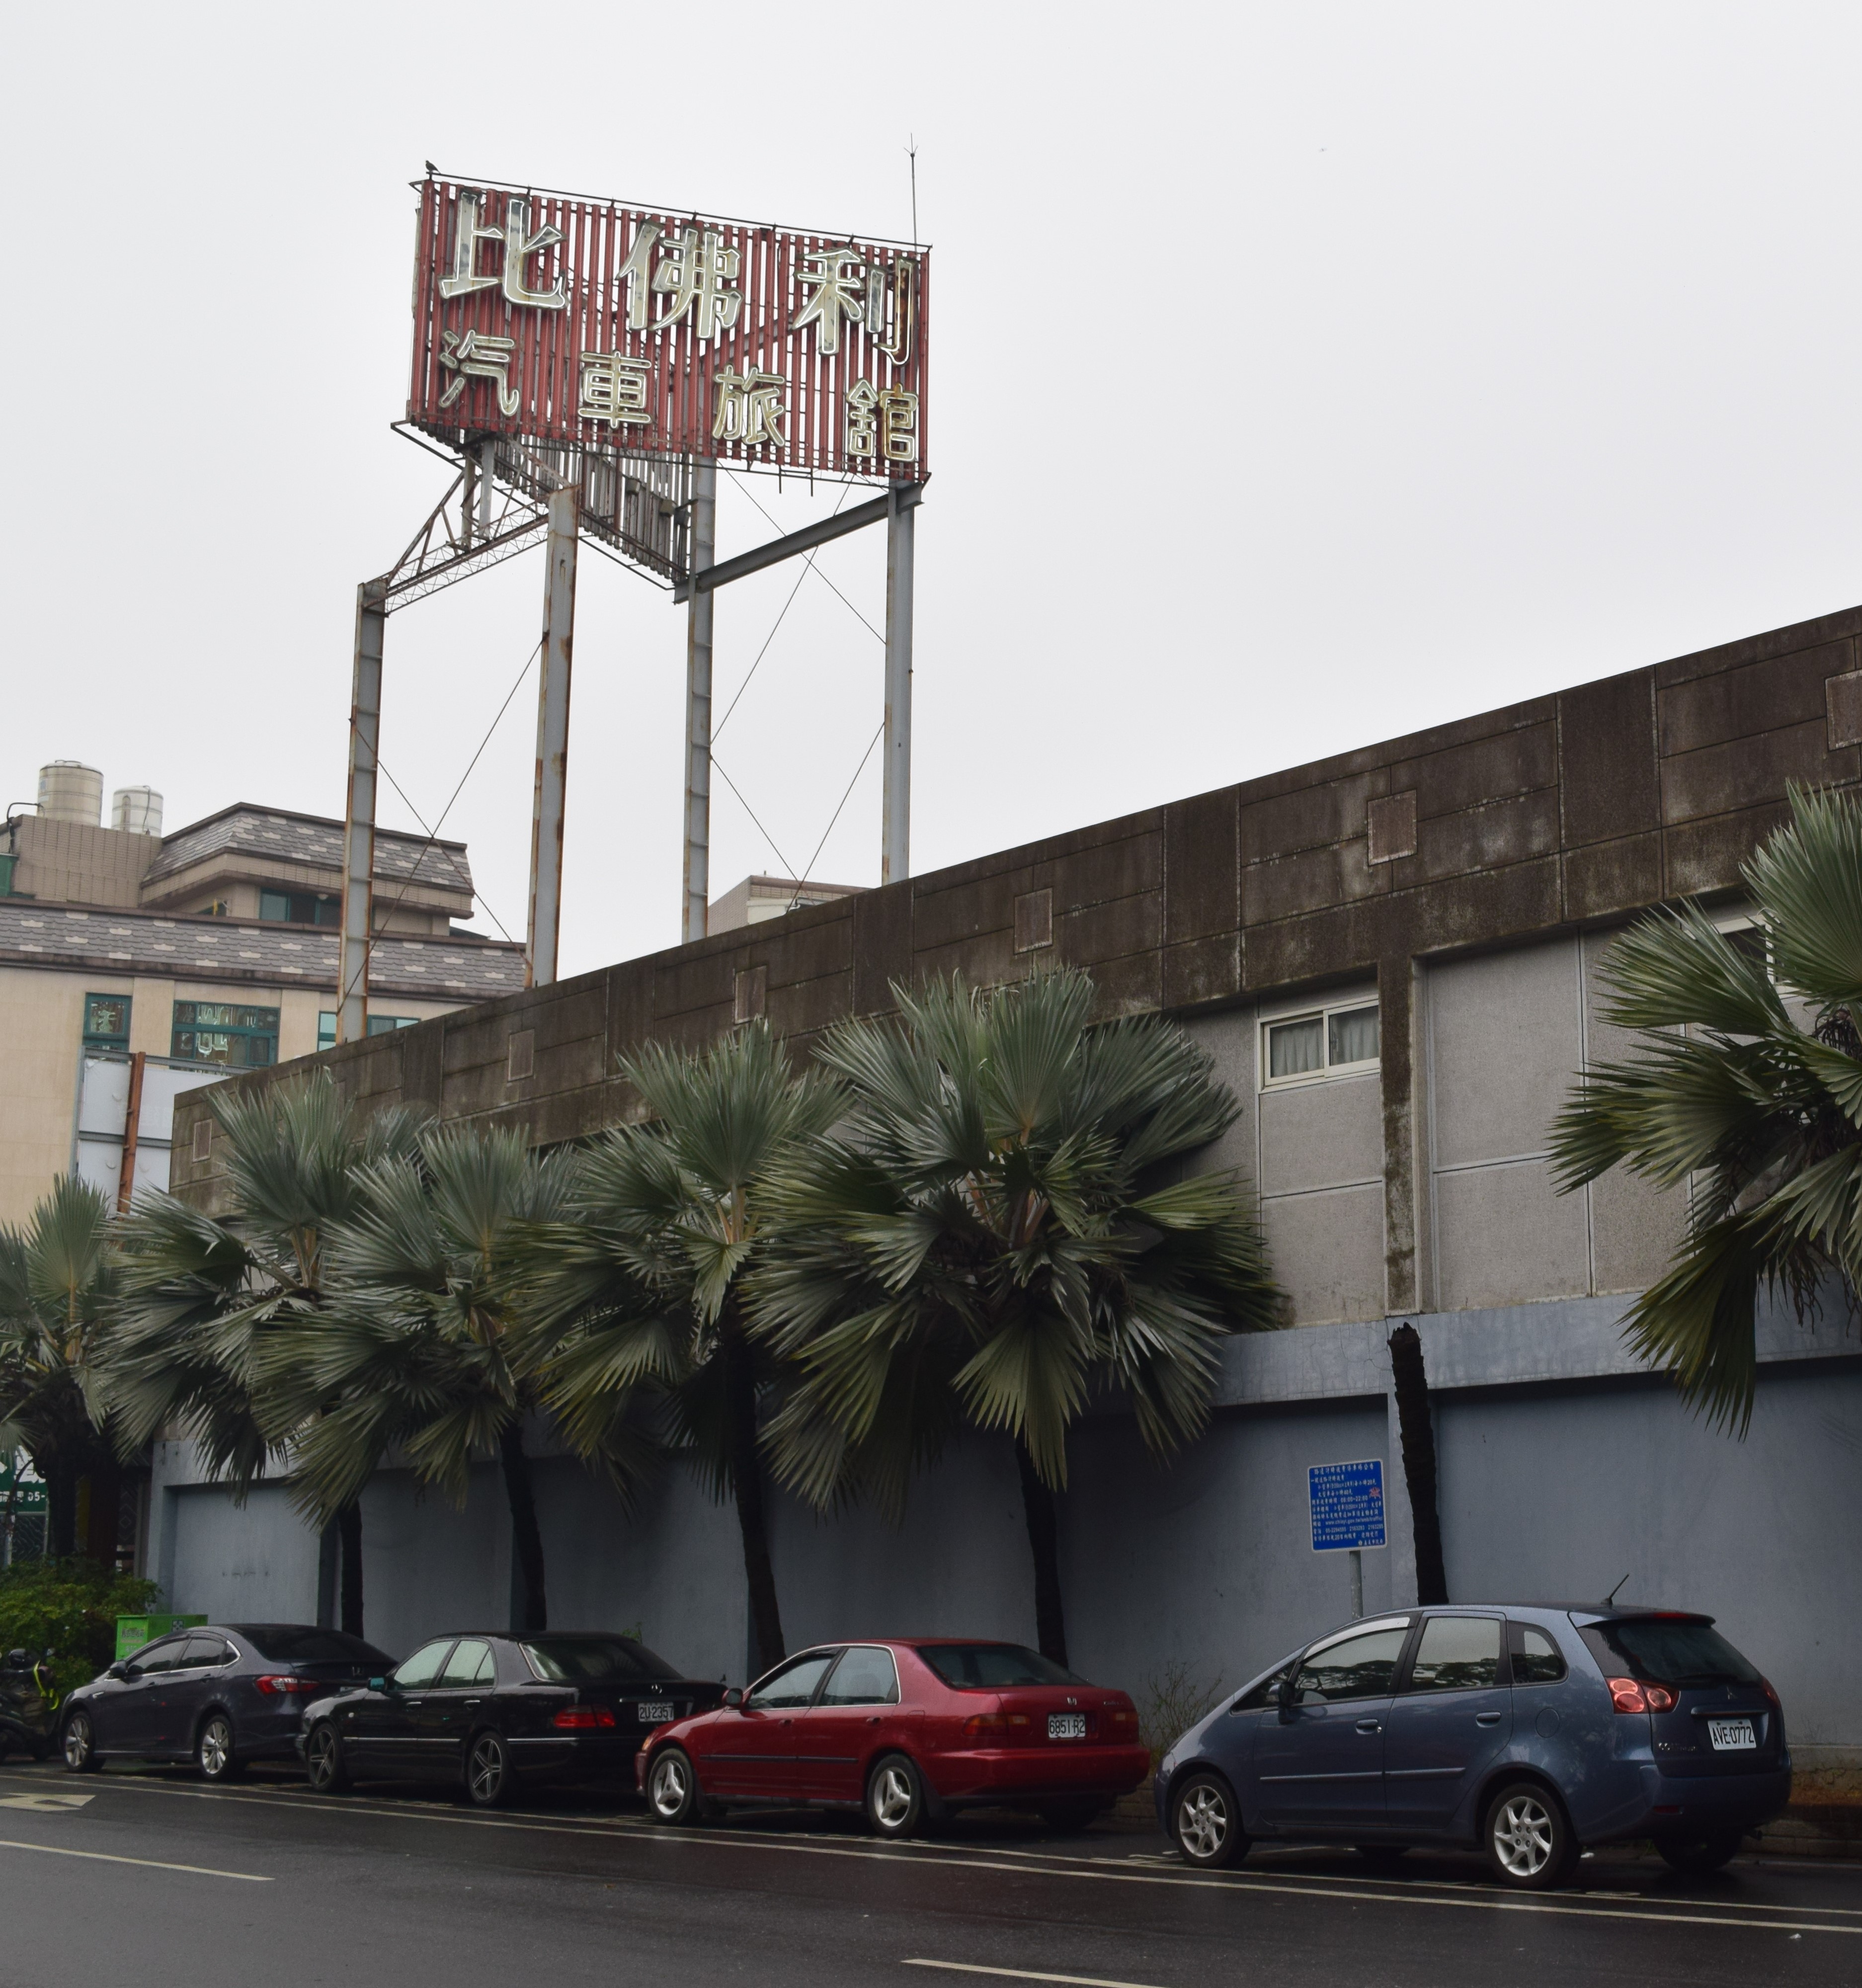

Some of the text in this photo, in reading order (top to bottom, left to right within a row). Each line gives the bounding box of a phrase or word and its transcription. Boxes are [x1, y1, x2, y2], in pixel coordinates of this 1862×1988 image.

[437, 187, 916, 367] 比佛利
[439, 329, 919, 462] 汽車旅館
[639, 1706, 674, 1719] 2U-2357
[1049, 1719, 1085, 1735] 6851-R2
[1712, 1726, 1755, 1745] AVE-0772
